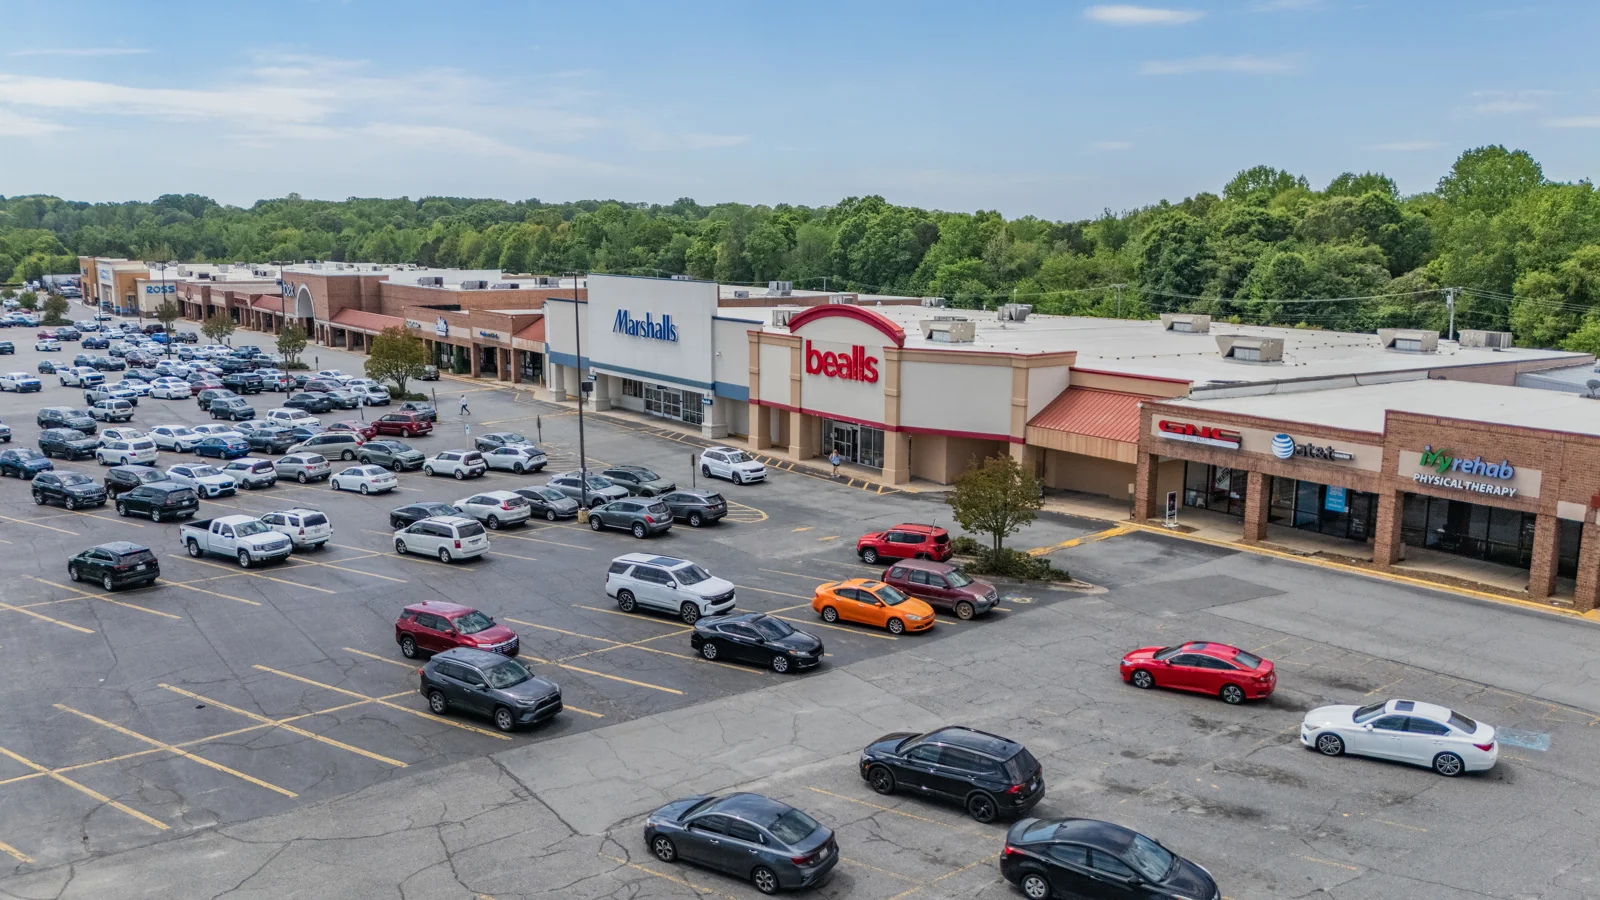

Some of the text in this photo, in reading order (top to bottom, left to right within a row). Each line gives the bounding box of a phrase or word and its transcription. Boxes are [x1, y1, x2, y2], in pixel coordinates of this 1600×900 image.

[146, 285, 176, 294] ROSS
[612, 308, 678, 342] Marshalls
[805, 339, 879, 384] bealls
[1158, 419, 1242, 443] GNC
[1295, 442, 1334, 461] at&t
[1412, 472, 1518, 498] PHYSICAL THERAPY
